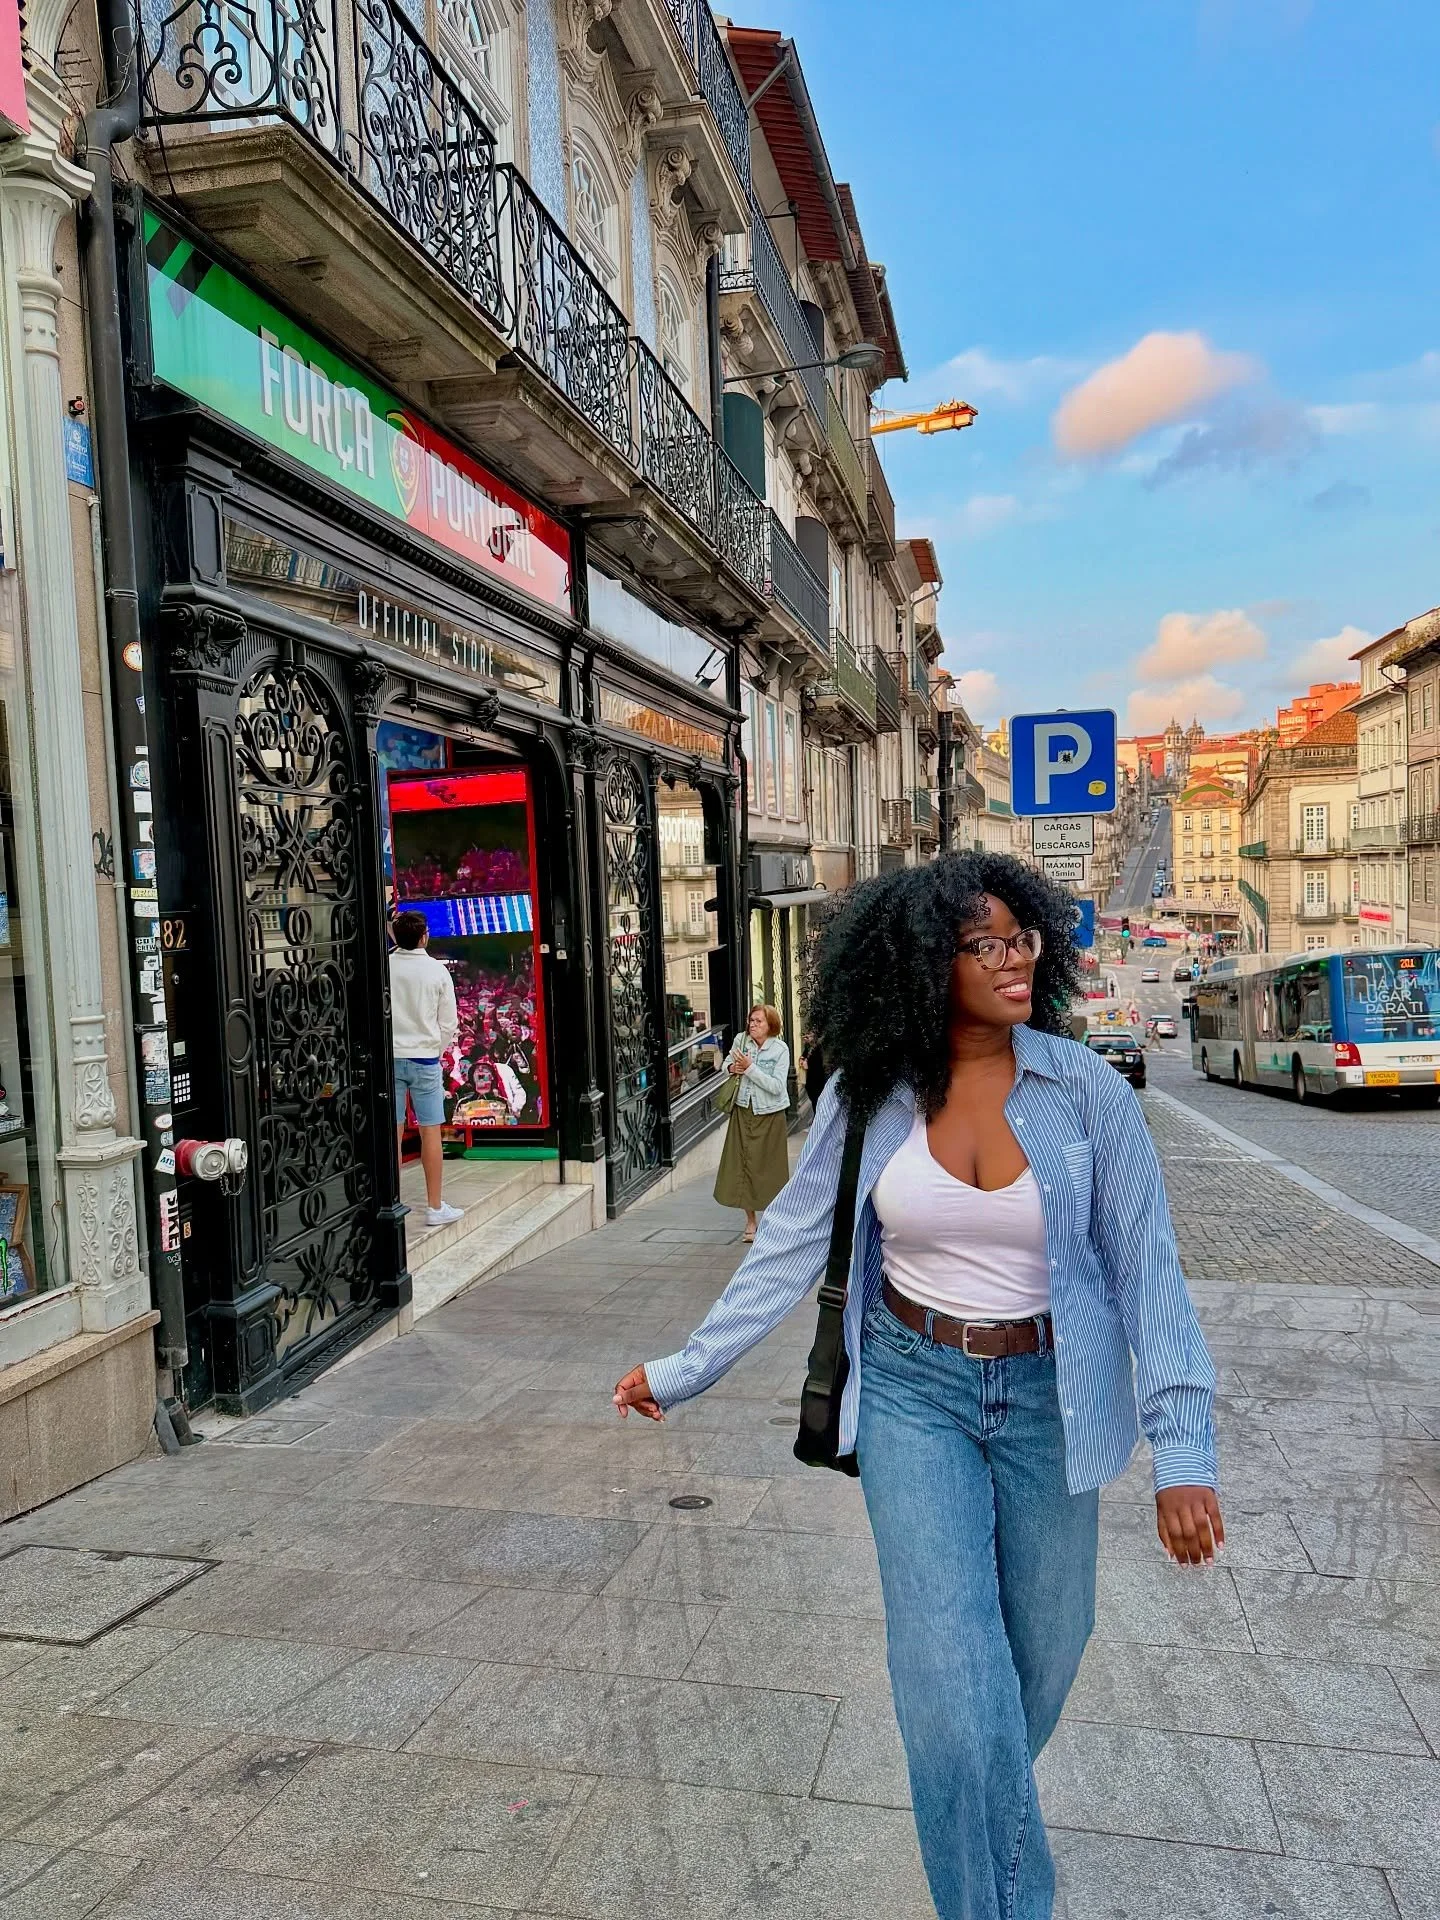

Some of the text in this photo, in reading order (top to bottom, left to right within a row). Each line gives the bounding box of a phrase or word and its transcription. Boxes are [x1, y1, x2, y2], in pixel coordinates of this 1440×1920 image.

[257, 324, 536, 577] FORÇA PORTUGAL
[358, 590, 494, 678] OFFICIAL STORE
[1034, 722, 1092, 805] P
[1043, 823, 1081, 831] CARGAS
[1060, 833, 1066, 841] E
[1035, 841, 1091, 850] DESCARGAS
[1045, 859, 1082, 869] MÁXIMO
[163, 919, 187, 949] 82
[1393, 977, 1418, 990] UM
[1359, 989, 1412, 1004] LUGAR
[1366, 1001, 1424, 1014] PARA TI
